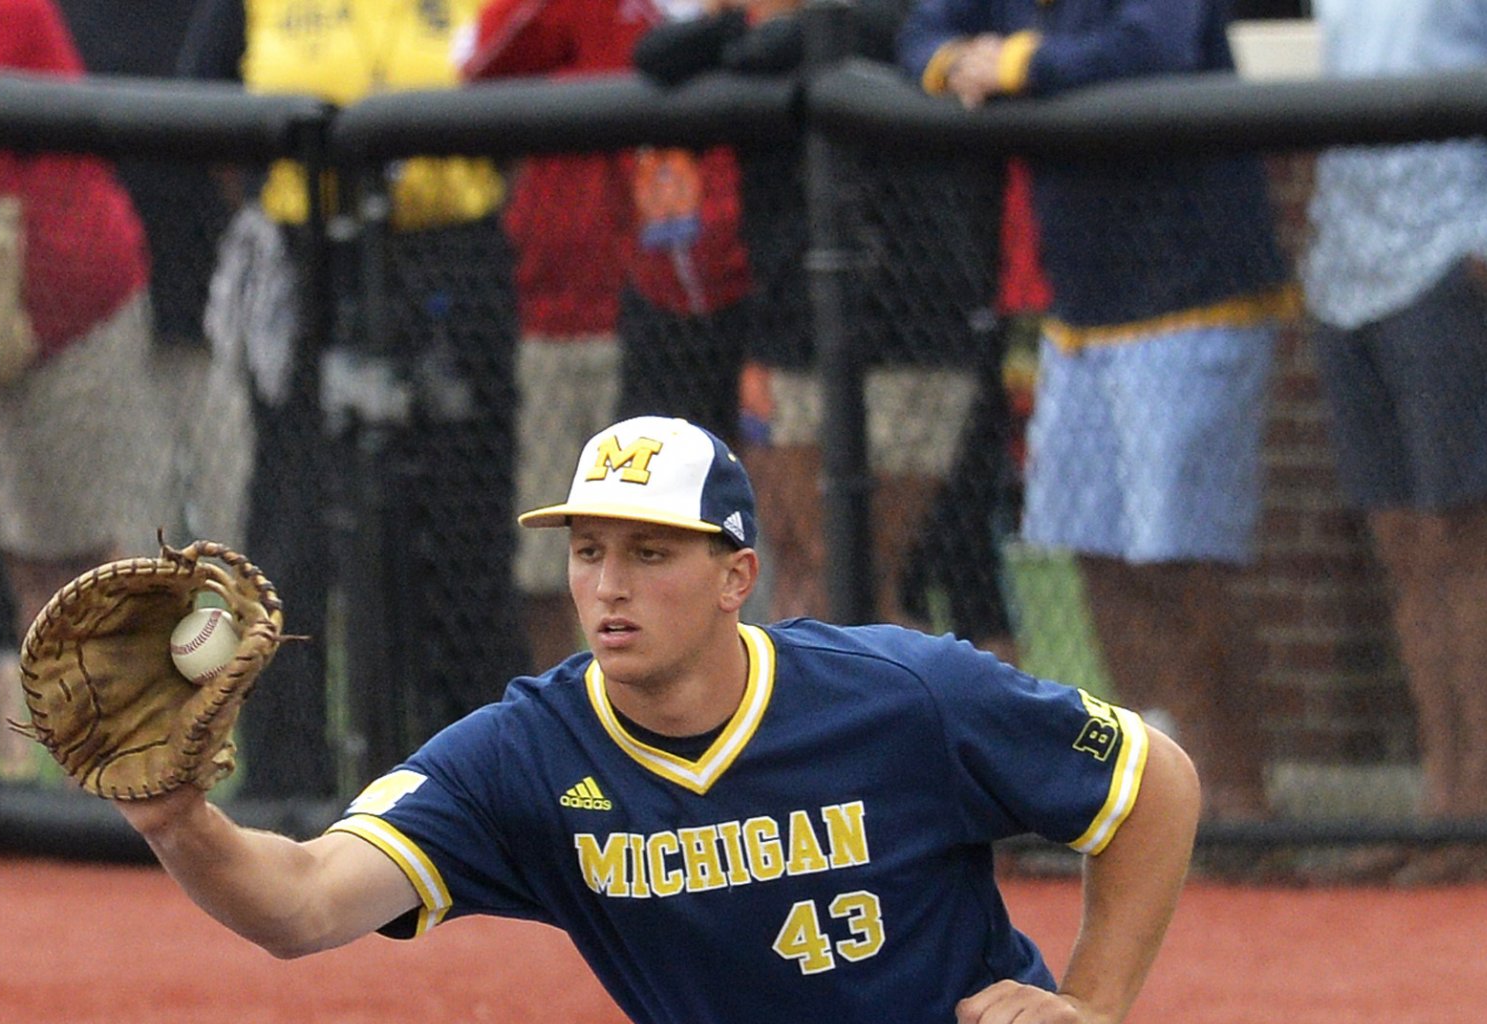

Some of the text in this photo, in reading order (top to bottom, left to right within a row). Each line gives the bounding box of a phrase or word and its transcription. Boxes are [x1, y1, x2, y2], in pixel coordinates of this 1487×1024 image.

[585, 435, 663, 485] M
[560, 795, 613, 811] adidas
[574, 801, 870, 898] MICHIGAN
[772, 890, 886, 975] 43
